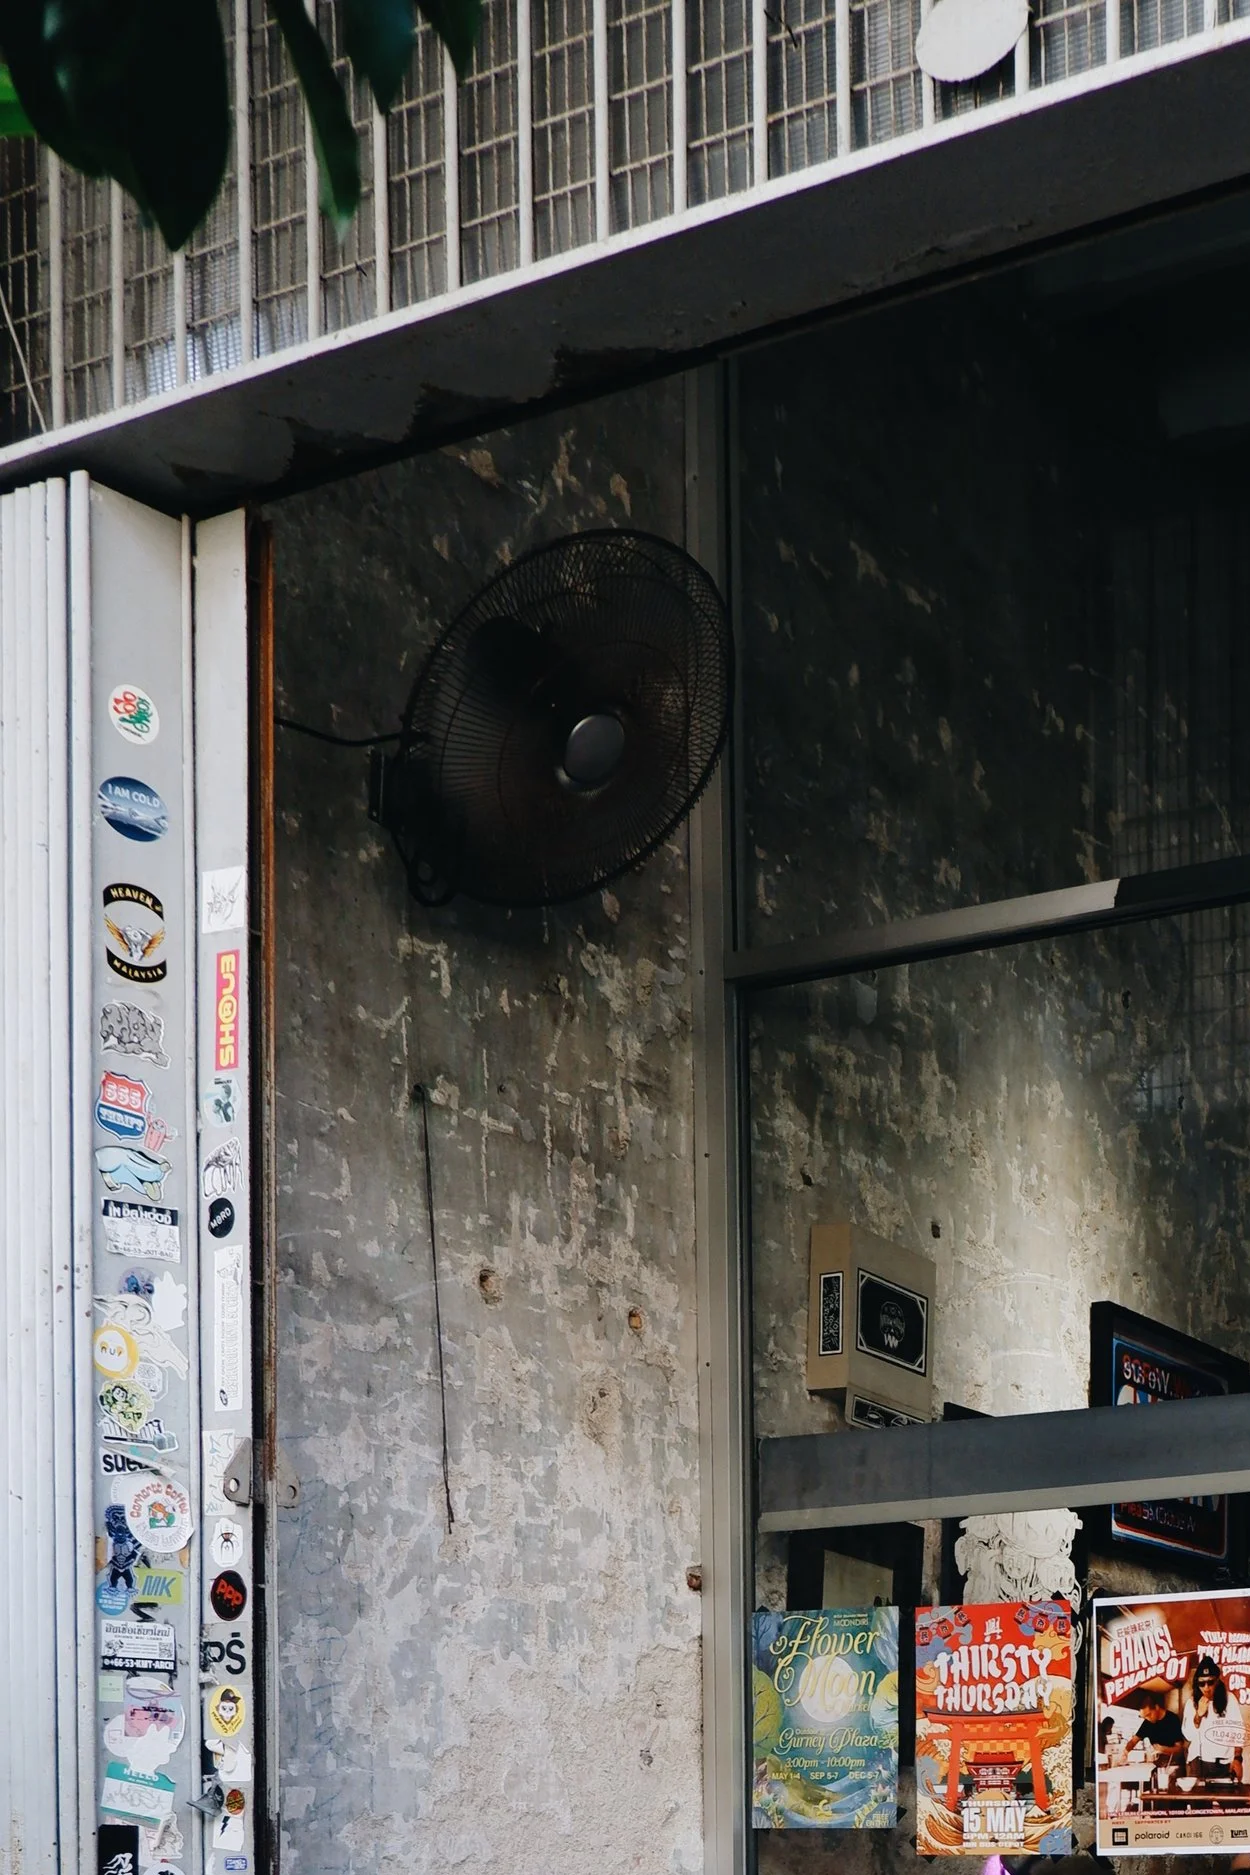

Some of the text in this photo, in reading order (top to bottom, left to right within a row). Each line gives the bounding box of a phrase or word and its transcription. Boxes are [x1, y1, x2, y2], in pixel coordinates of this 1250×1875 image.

[108, 783, 160, 808] I AM COLD
[110, 887, 154, 909] HEAVEN
[112, 959, 164, 978] MALAYSIA
[769, 1615, 880, 1659] Flower
[934, 1644, 1051, 1684] THIRSTY
[1109, 1624, 1177, 1678] CHAOS!
[774, 1652, 877, 1710] Moon
[1105, 1656, 1188, 1705] PENANG 01
[934, 1681, 1053, 1714] THURSDAY
[774, 1727, 879, 1755] Gurney Plaza
[772, 1772, 789, 1780] MAY
[810, 1772, 825, 1780] SEP
[848, 1771, 866, 1780] DEC
[785, 1757, 818, 1769] 3:00pm
[826, 1757, 866, 1769] 10:00pm
[961, 1807, 1026, 1833] 15 MAY
[1134, 1831, 1171, 1842] polaroid
